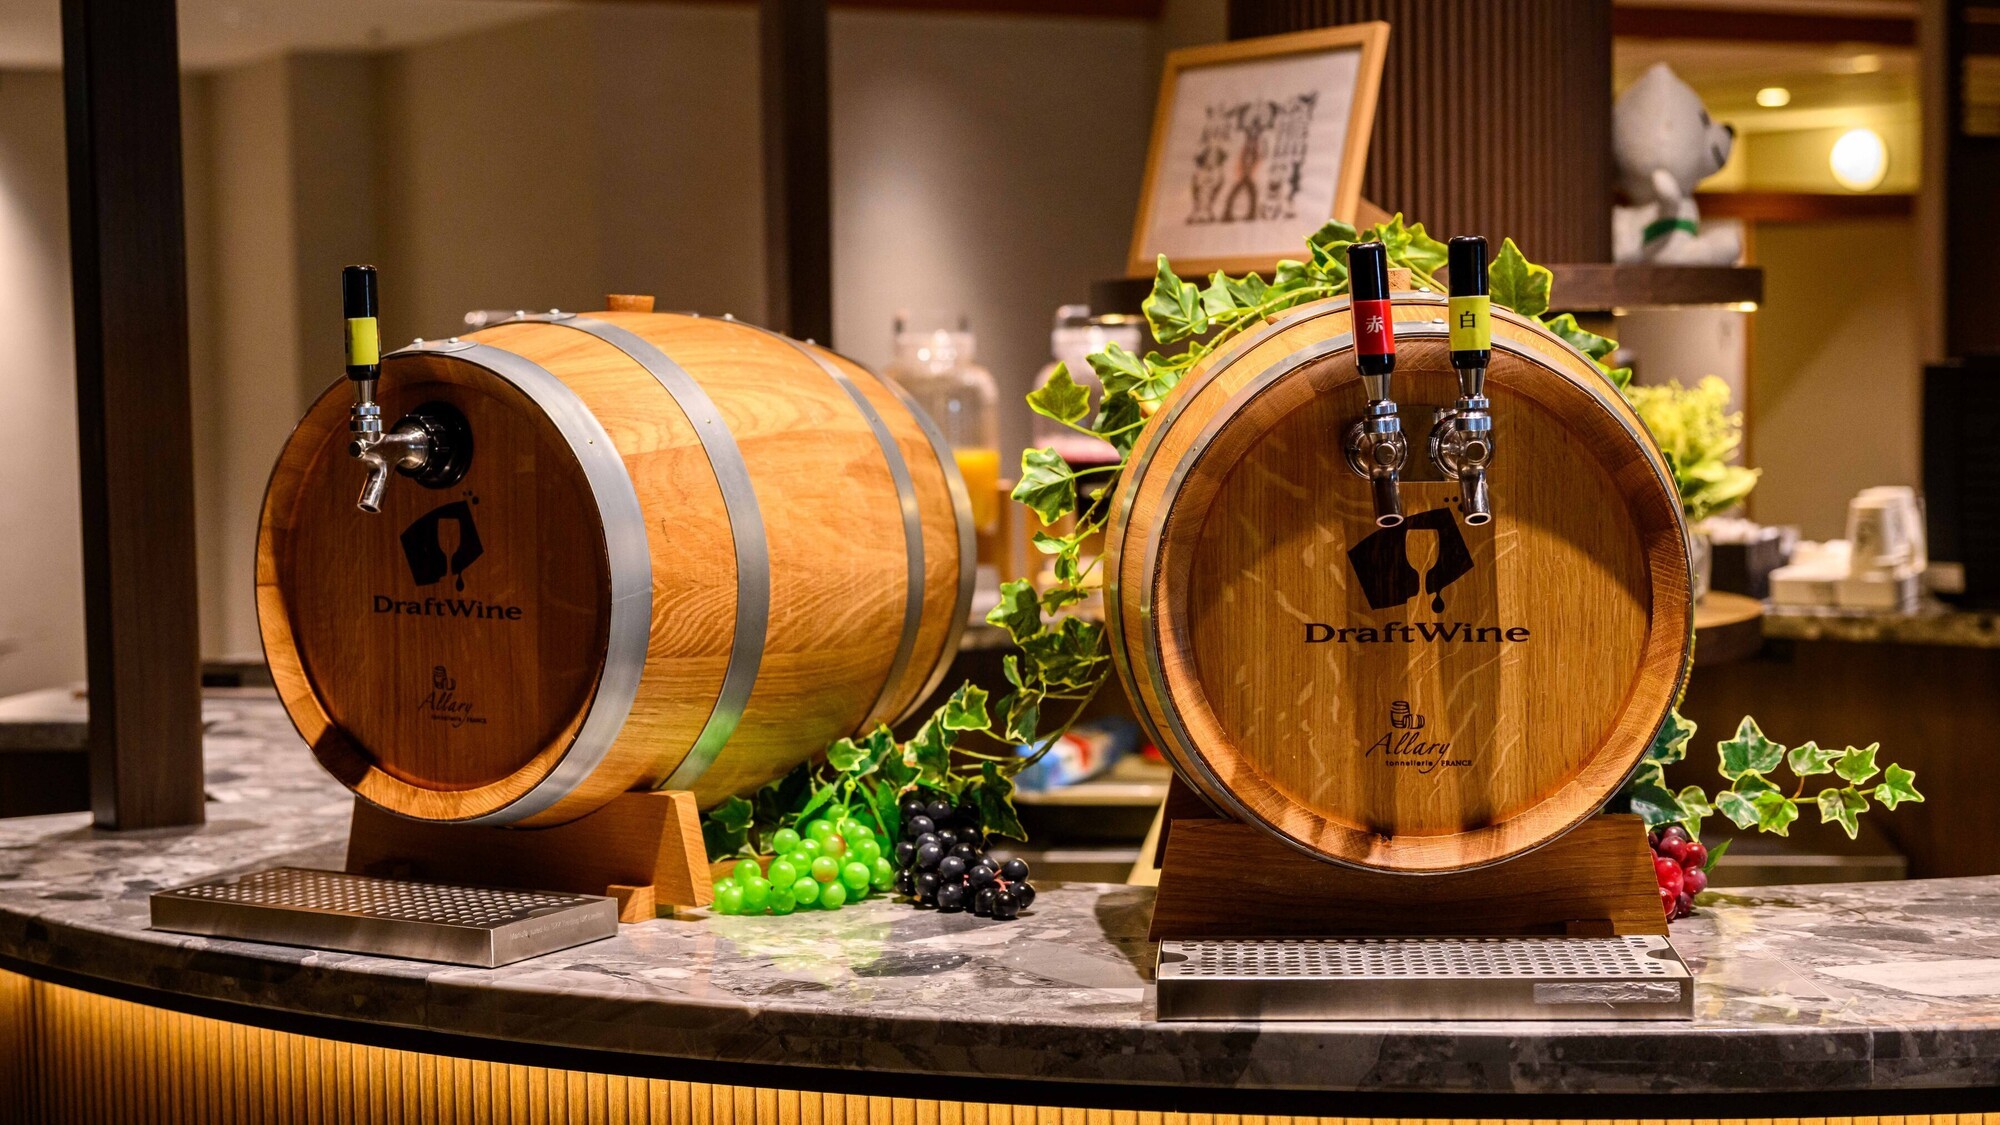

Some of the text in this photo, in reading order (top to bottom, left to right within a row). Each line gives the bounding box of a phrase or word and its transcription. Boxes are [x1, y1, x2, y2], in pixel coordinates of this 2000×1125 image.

[1365, 315, 1384, 334] 赤
[1459, 311, 1476, 329] 白
[373, 595, 523, 621] DraftWine
[1304, 621, 1531, 644] DraftWine
[417, 691, 473, 729] Allary
[1365, 731, 1451, 774] Allary
